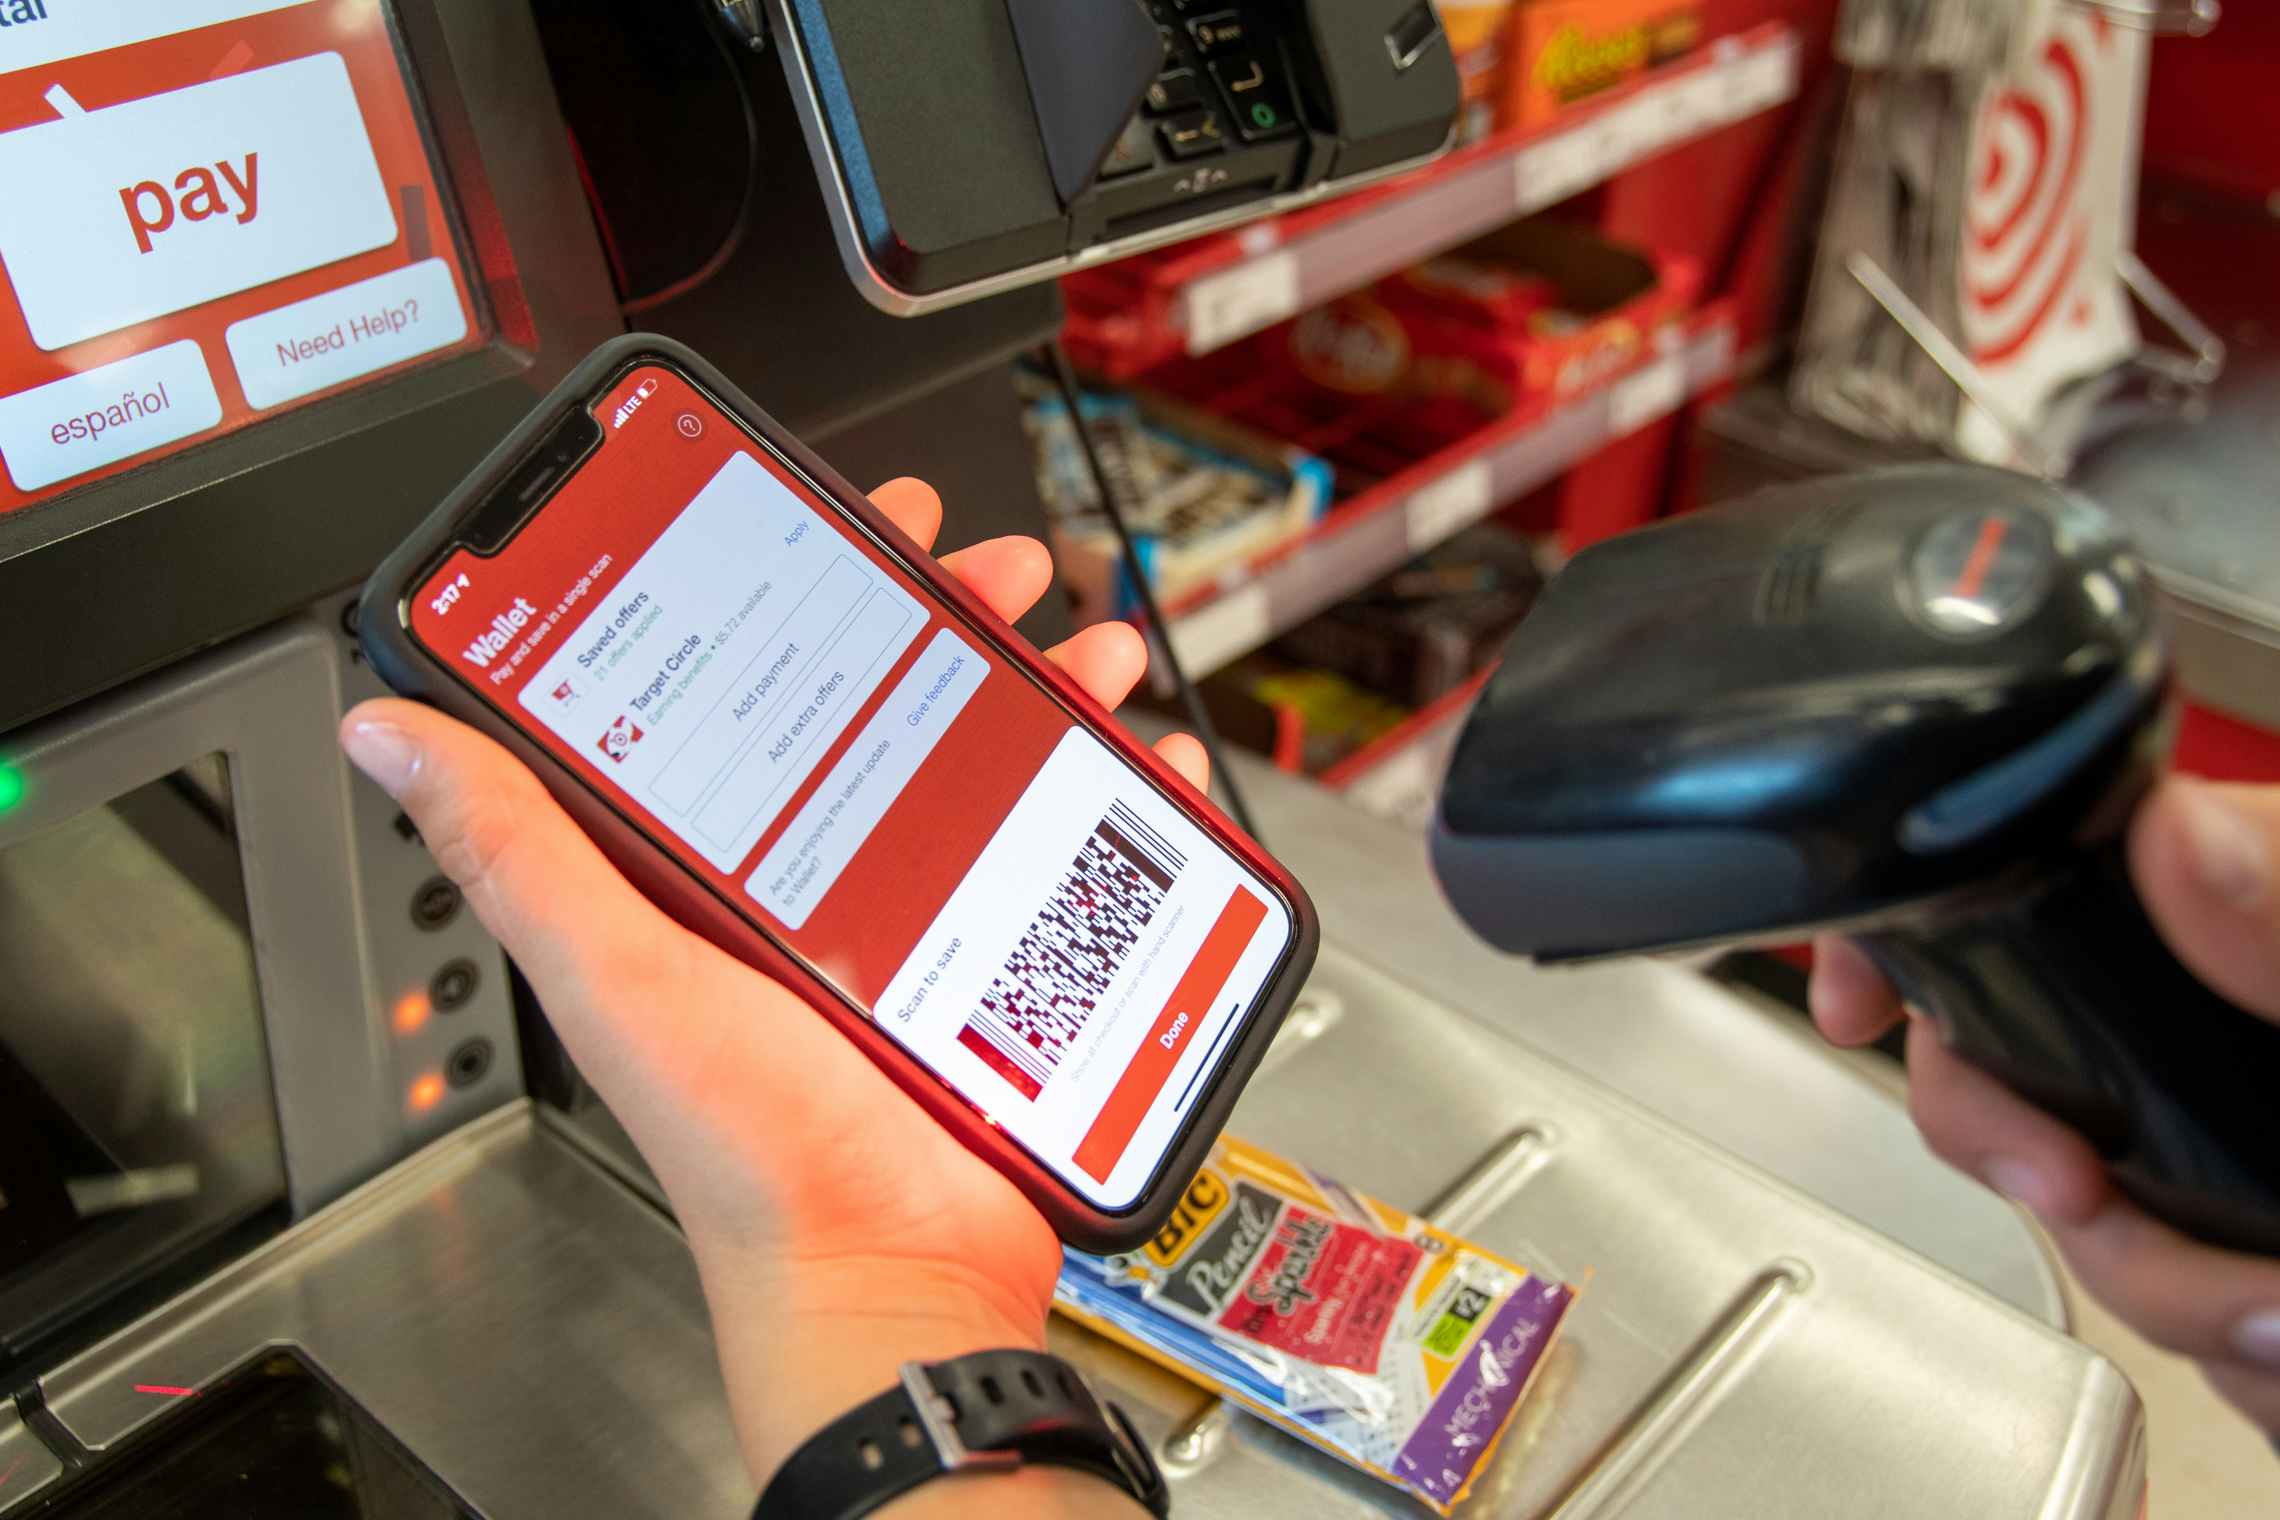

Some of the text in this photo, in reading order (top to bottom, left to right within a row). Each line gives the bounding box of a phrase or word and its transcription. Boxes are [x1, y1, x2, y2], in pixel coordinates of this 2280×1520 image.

[119, 152, 257, 254] pay
[276, 299, 420, 367] Need Help?
[51, 382, 170, 446] español
[622, 395, 643, 415] LTE
[784, 520, 810, 547] Apply
[430, 583, 461, 616] 2:17
[461, 597, 538, 668] Wallet
[489, 662, 515, 685] Pay
[509, 641, 532, 666] and
[526, 621, 552, 647] save
[544, 611, 561, 625] in
[563, 575, 593, 607] single
[587, 553, 613, 579] scan
[576, 591, 650, 669] Saved offers
[607, 639, 634, 668] offers
[630, 603, 664, 641] applied
[676, 651, 714, 691] benefits
[737, 581, 773, 621] available
[628, 634, 702, 712] Target Circle
[732, 642, 800, 722] Add payment
[906, 655, 966, 727] Give feedback
[767, 671, 845, 764] Add extra offers
[784, 856, 803, 880] you
[827, 799, 846, 817] the
[840, 771, 867, 800] latest
[862, 739, 891, 774] update
[897, 937, 962, 1023] Scan to save
[1146, 935, 1167, 960] hand
[1159, 1011, 1189, 1050] Done
[1153, 1175, 1220, 1256] BIC
[1186, 1195, 1270, 1311] Pencil
[1444, 1317, 1541, 1434] MECHNICAL
